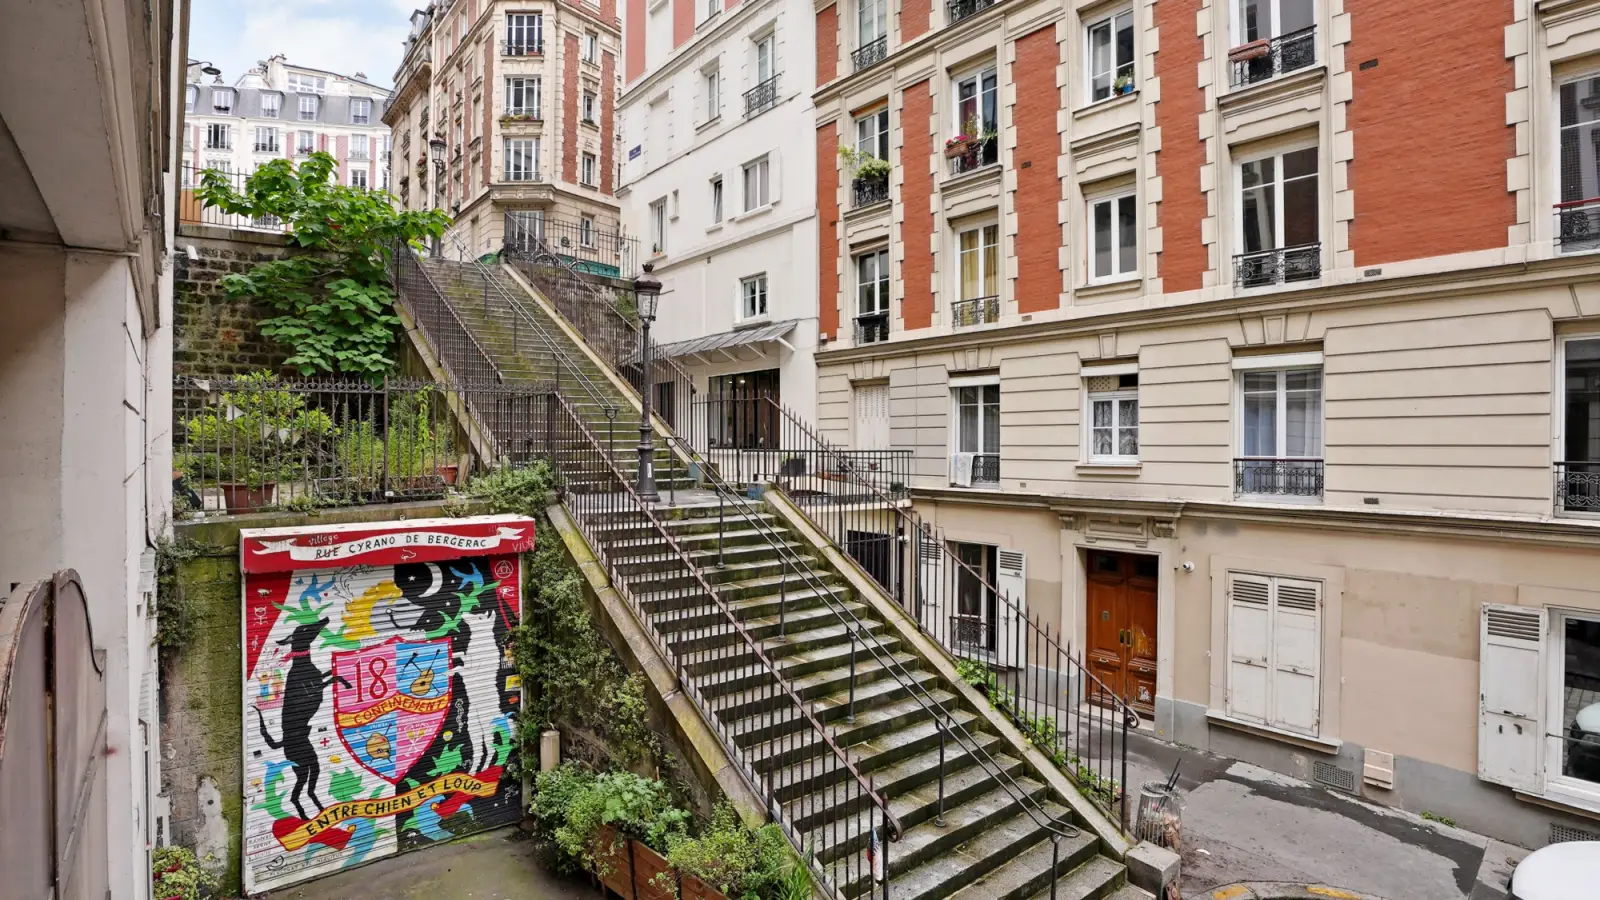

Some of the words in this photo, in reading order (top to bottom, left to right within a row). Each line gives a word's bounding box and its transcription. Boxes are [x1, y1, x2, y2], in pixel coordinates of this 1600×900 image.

[315, 547, 340, 558] RUE
[348, 536, 396, 554] CYRANO
[406, 534, 419, 543] DE
[428, 534, 487, 548] BERGERAC
[353, 656, 388, 703] 18
[354, 696, 446, 725] CONFINEMENT
[305, 804, 358, 836] ENTRE
[364, 796, 411, 815] CHIEN
[418, 783, 436, 799] ET
[443, 778, 482, 792] LOUP
